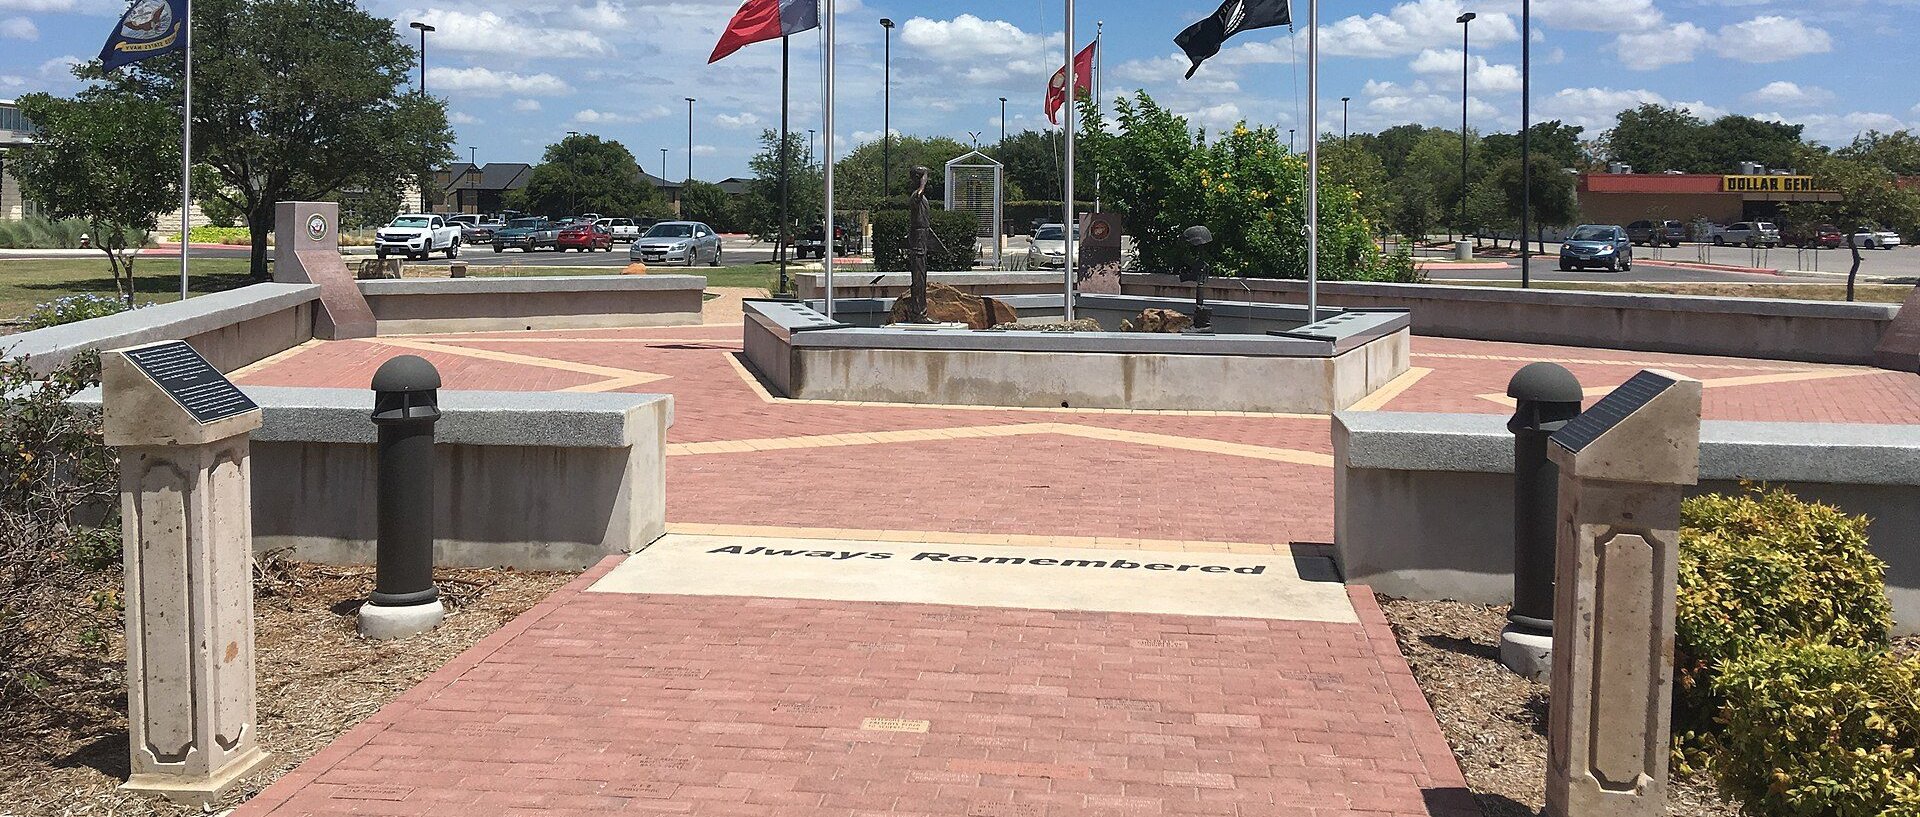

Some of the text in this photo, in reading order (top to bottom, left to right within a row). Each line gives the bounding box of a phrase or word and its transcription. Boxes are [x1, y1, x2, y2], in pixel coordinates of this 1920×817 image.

[1727, 177, 1779, 190] DOLLAR
[706, 545, 1267, 576] Always Remembered
